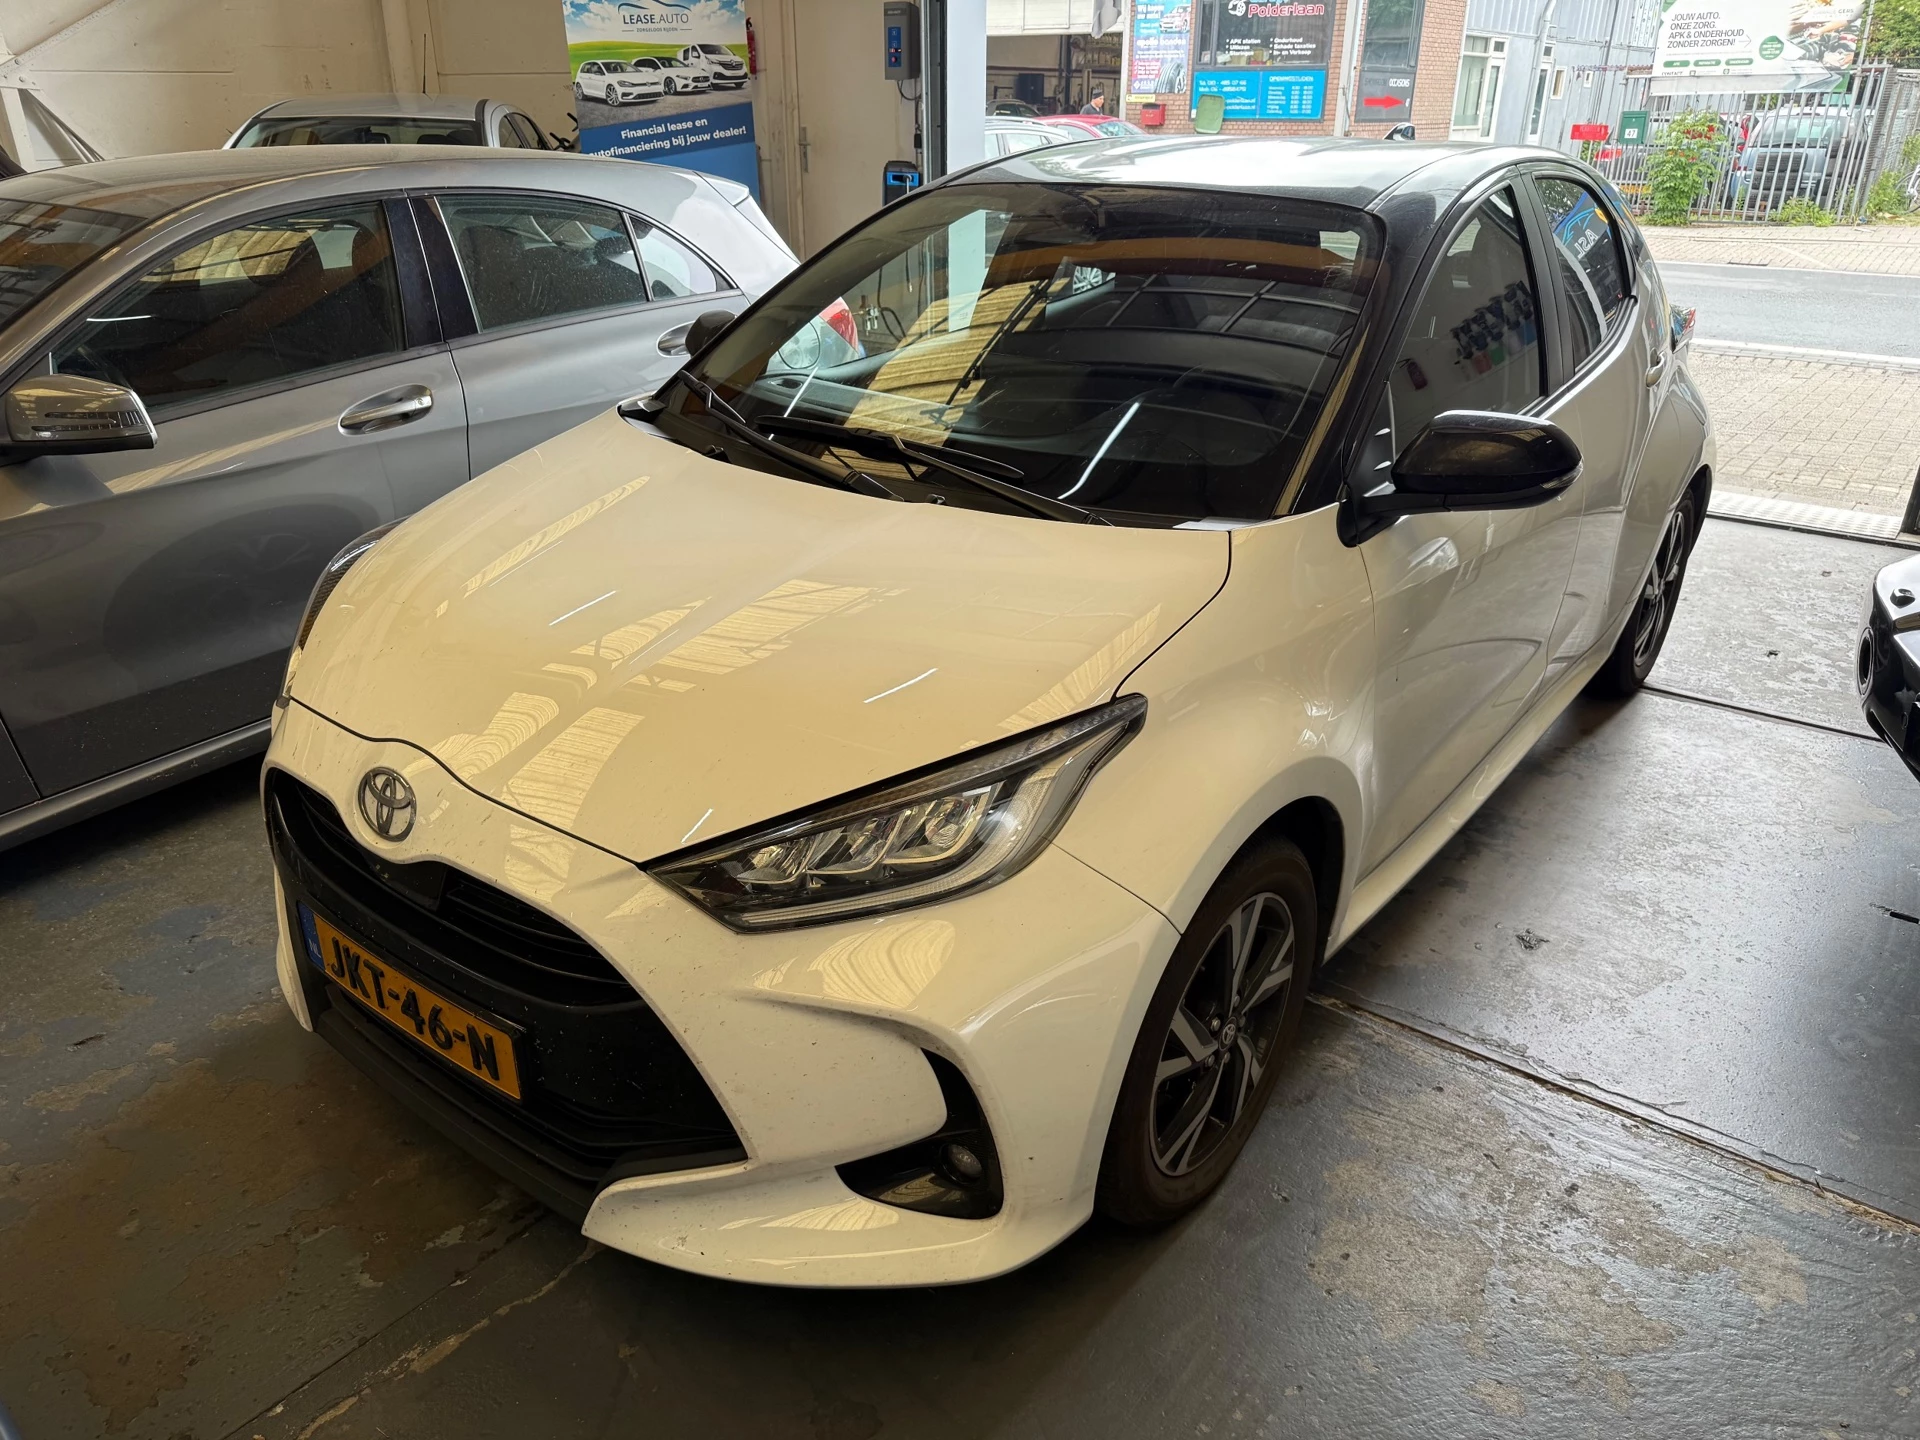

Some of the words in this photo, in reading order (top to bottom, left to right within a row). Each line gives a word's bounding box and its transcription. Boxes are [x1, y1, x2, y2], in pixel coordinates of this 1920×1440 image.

[1248, 3, 1325, 17] Polderlaan
[622, 13, 689, 25] LEASE.AUTO
[1671, 13, 1696, 22] JOUW
[1696, 11, 1721, 20] AUTO.
[1670, 22, 1693, 31] ONZE
[1693, 21, 1717, 30] ZORG.
[1668, 31, 1685, 39] APK
[1686, 31, 1692, 39] &
[1693, 29, 1745, 38] ONDERHOUD
[1667, 40, 1700, 49] ZONDER
[1700, 38, 1736, 47] ZORGEN!
[620, 123, 666, 140] Financial
[667, 119, 693, 133] lease
[695, 117, 708, 128] en
[1626, 130, 1636, 138] 47
[671, 131, 686, 147] bij
[686, 130, 711, 144] jouw
[712, 125, 747, 139] dealer!
[307, 937, 322, 959] NL
[331, 936, 500, 1082] JKT-46-N
